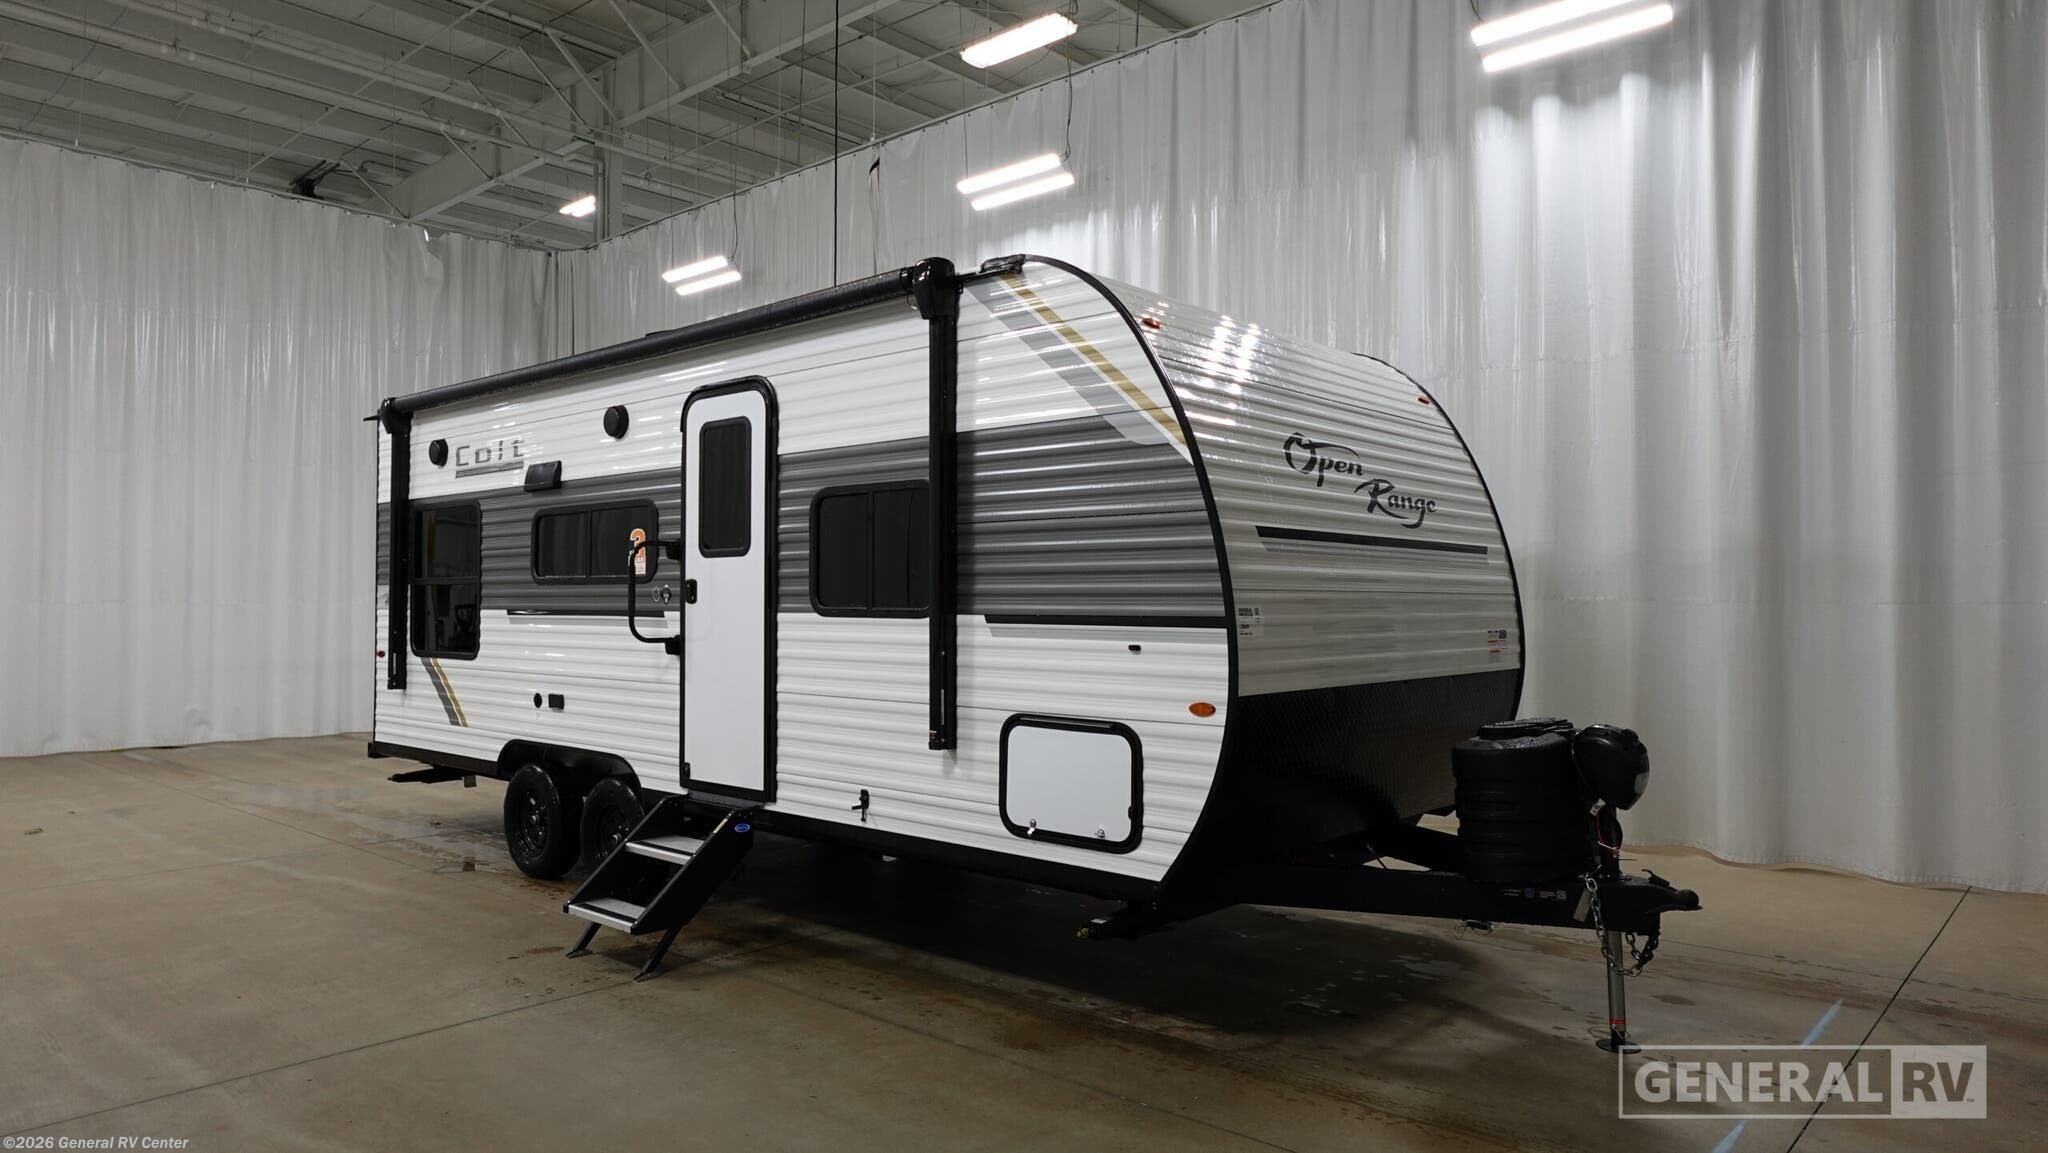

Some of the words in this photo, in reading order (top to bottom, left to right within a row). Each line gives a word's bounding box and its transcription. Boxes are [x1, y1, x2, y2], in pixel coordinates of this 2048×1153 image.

[455, 440, 524, 467] Colt
[1283, 432, 1364, 487] Open
[1354, 479, 1437, 529] Range
